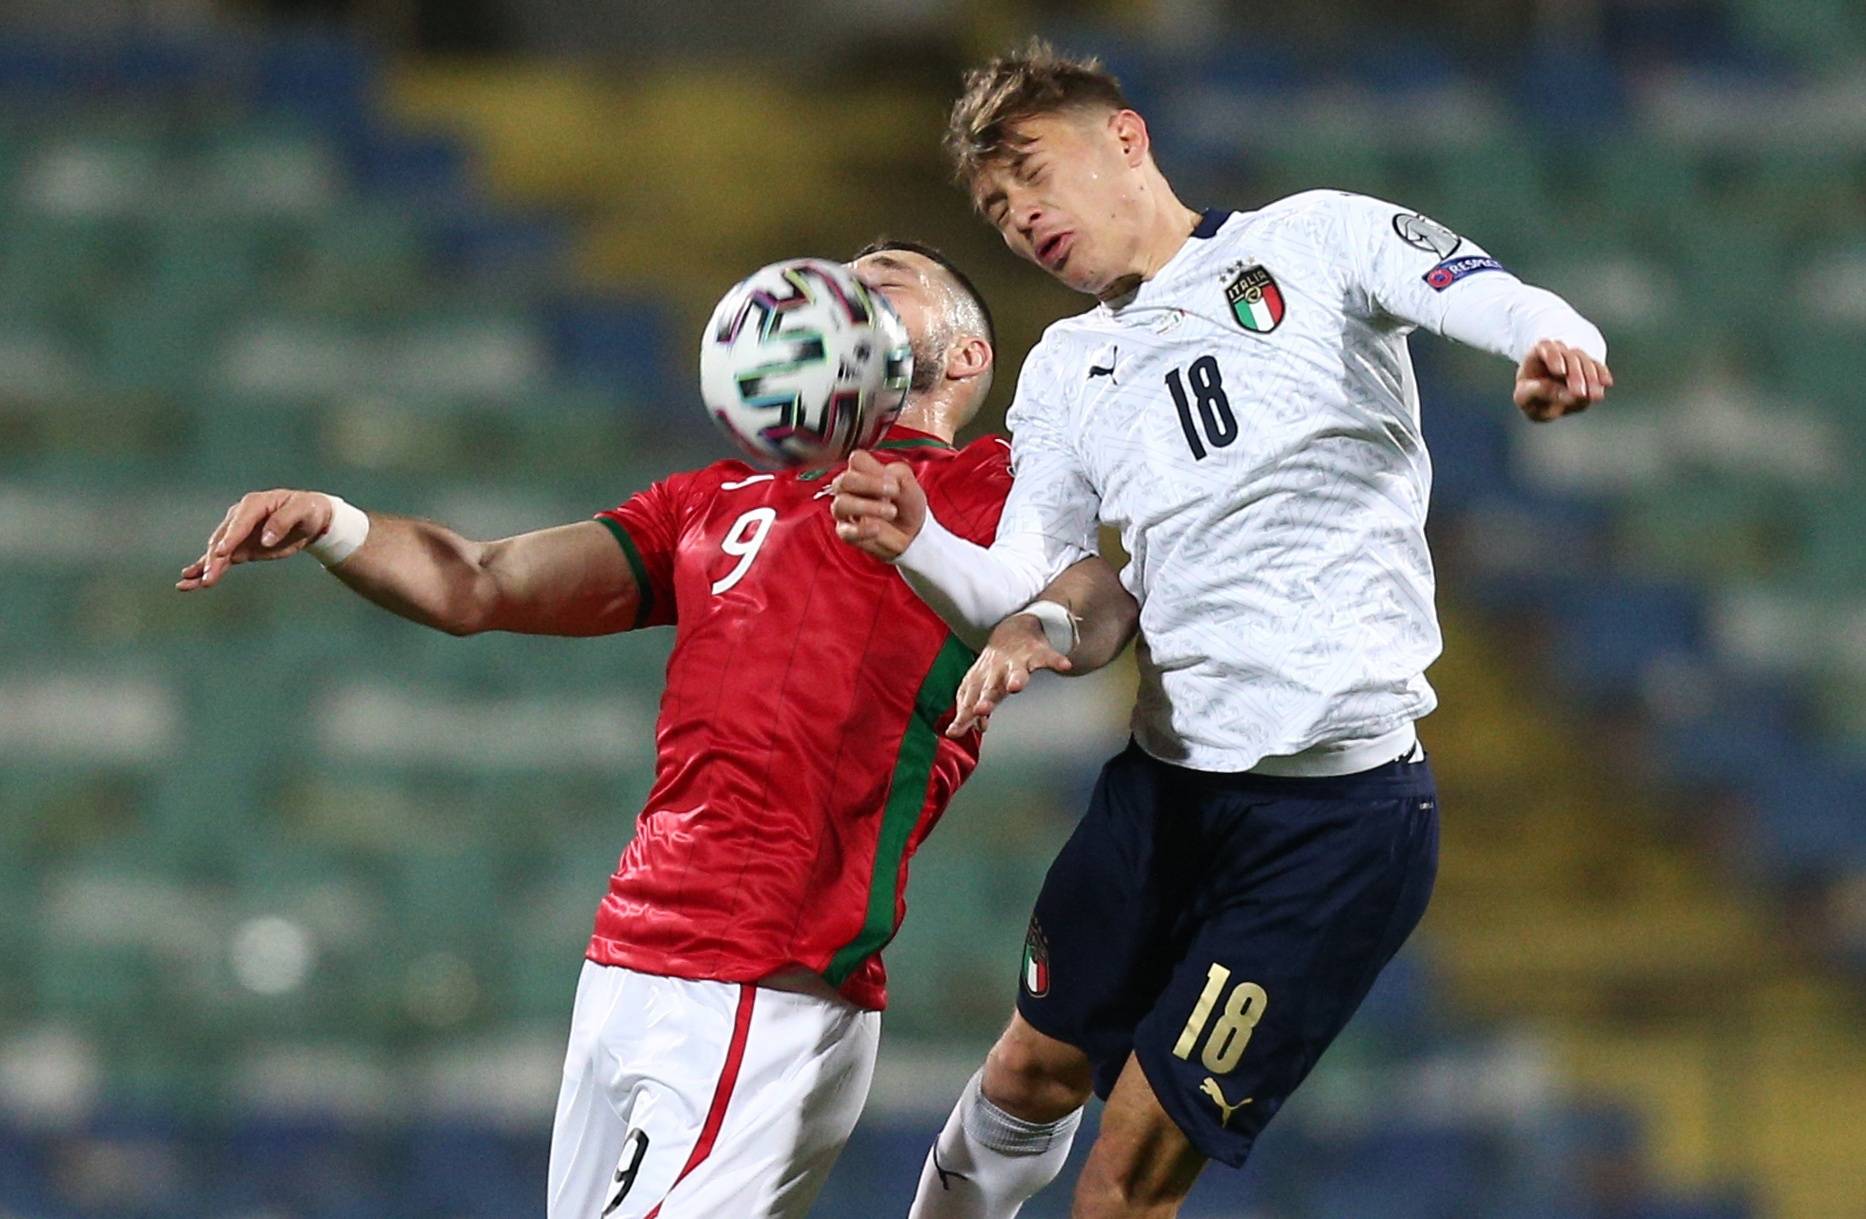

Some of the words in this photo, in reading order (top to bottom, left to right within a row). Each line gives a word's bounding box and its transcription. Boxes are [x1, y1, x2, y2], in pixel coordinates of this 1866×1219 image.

[1228, 271, 1267, 299] ITALIA
[1165, 355, 1238, 461] 18
[712, 507, 777, 595] 9
[1172, 962, 1268, 1074] 18
[601, 1127, 650, 1216] 9
